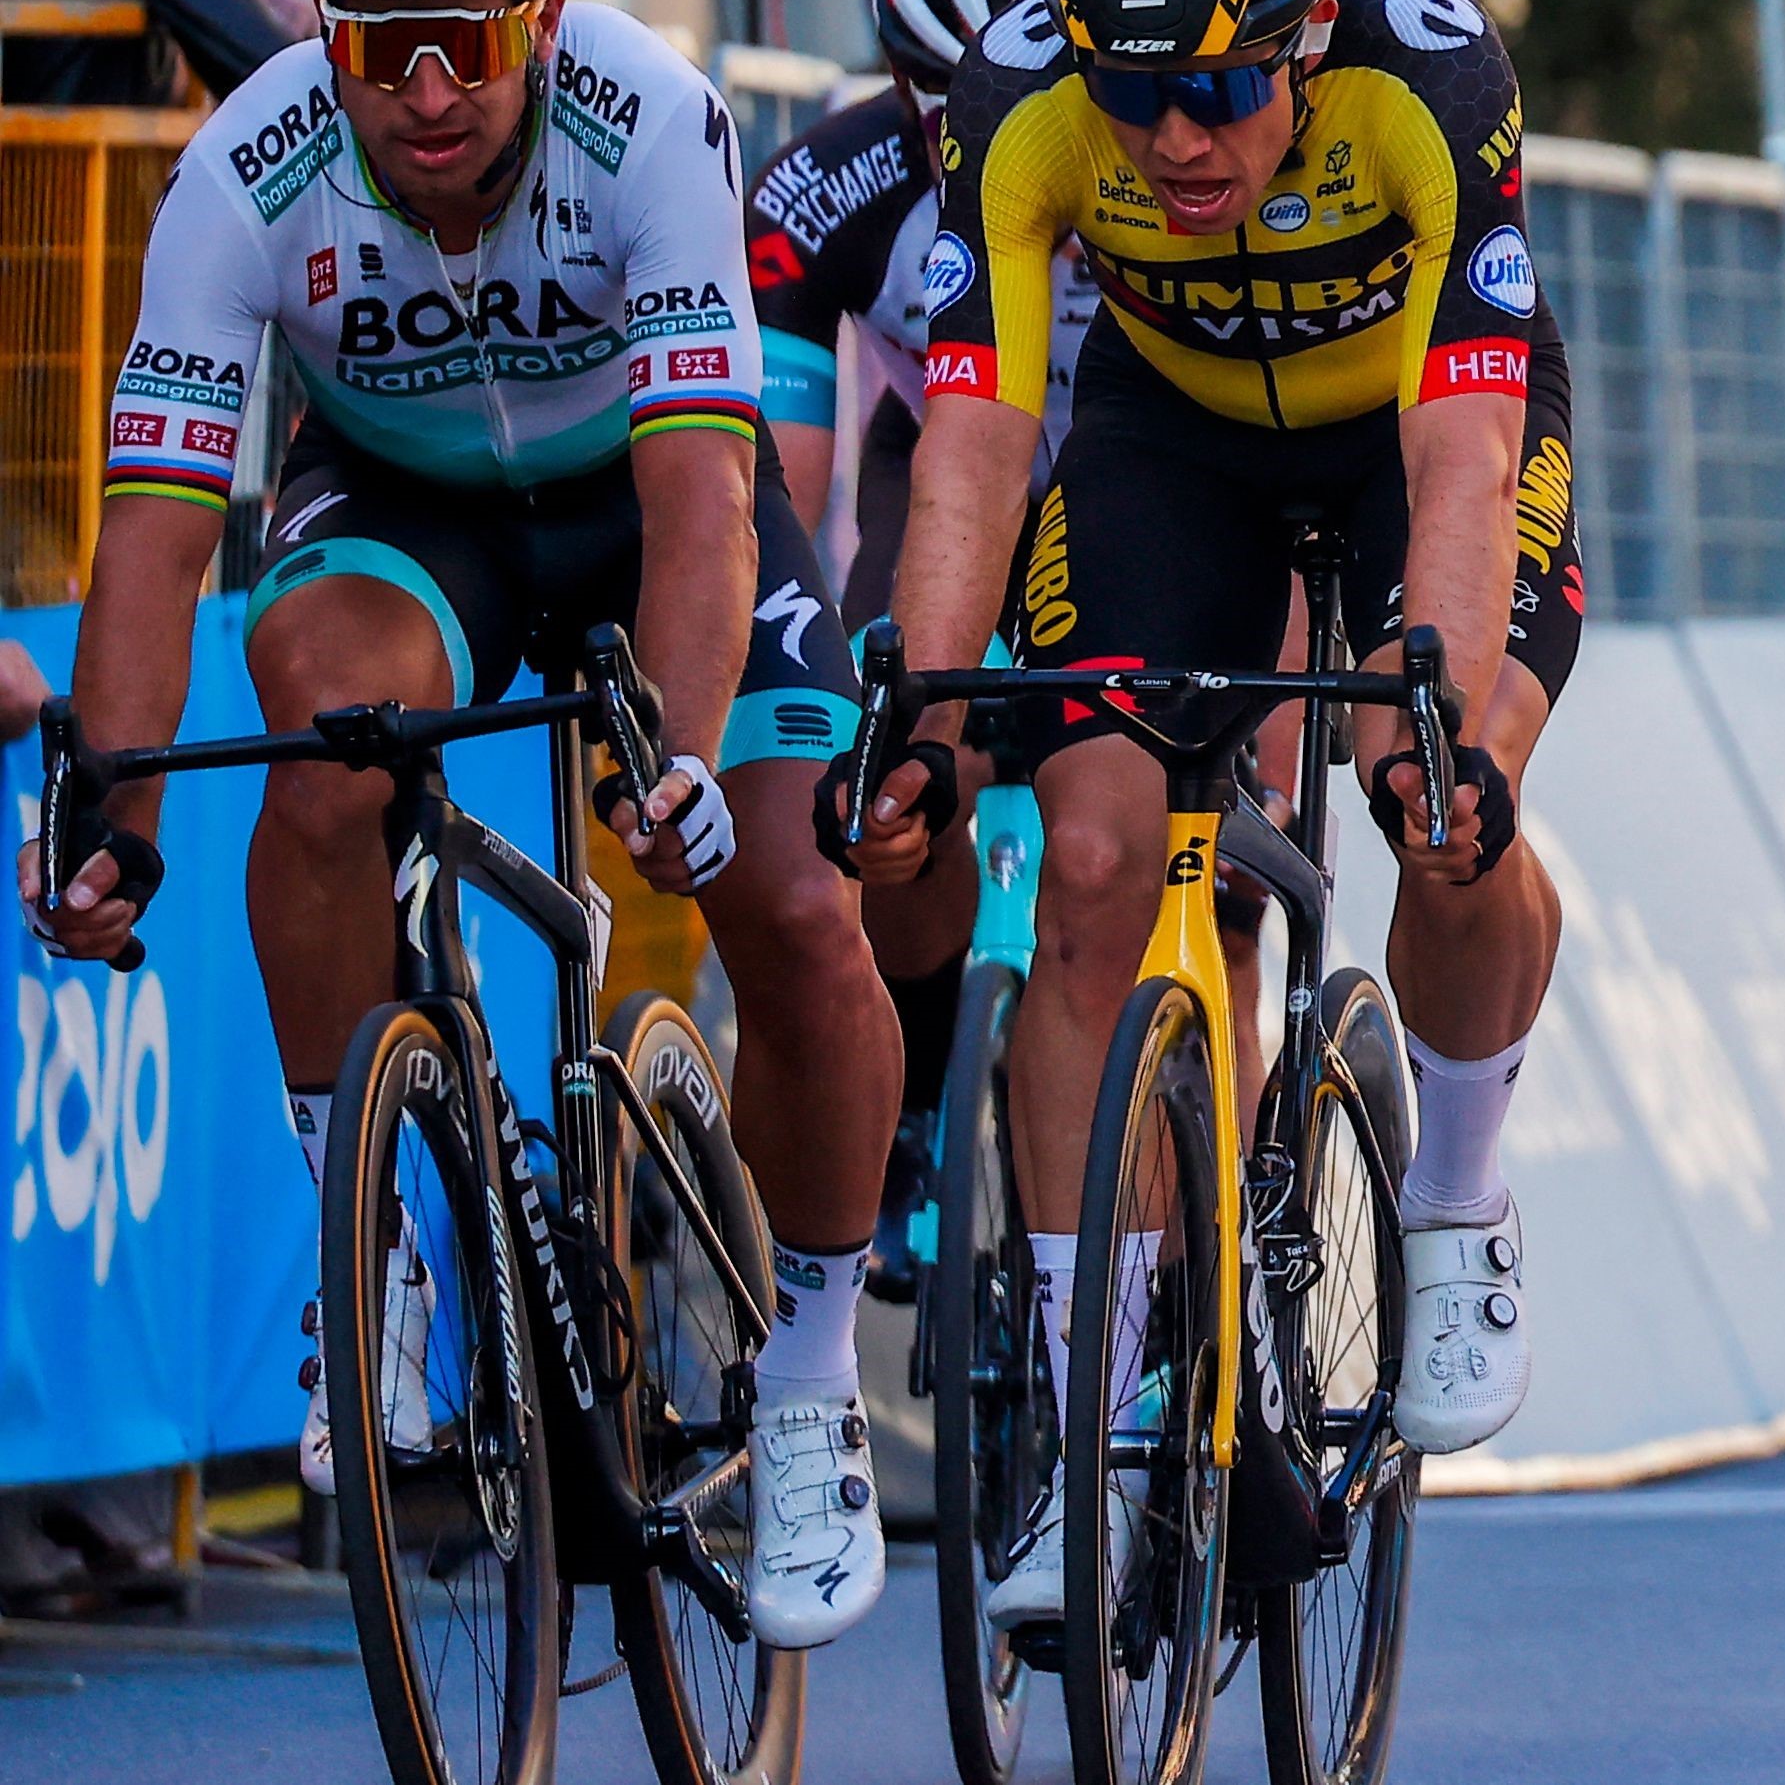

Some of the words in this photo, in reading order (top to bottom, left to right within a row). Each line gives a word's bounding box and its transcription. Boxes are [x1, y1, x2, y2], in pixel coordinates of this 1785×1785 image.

[1110, 38, 1176, 53] LAZER
[555, 50, 642, 137] BORA
[229, 85, 342, 186] BORA
[256, 127, 343, 209] hansgrohe
[754, 145, 823, 223] BIKE
[783, 134, 908, 255] EXCHANGE
[1317, 174, 1355, 198] AGU
[310, 257, 333, 280] ÖTZ
[311, 278, 334, 294] TAL
[336, 279, 605, 358] BORA
[127, 341, 245, 389] BORA
[346, 338, 613, 391] hansgrohe
[675, 351, 720, 365] ÖTZ
[677, 364, 721, 376] TAL
[1449, 350, 1527, 387] HEM
[117, 416, 157, 430] ÖTZ
[192, 424, 232, 441] ÖTZ
[117, 430, 153, 443] TAL
[191, 436, 229, 453] TAL
[1520, 436, 1573, 576] JUMBO
[1133, 678, 1172, 688] GARMIN
